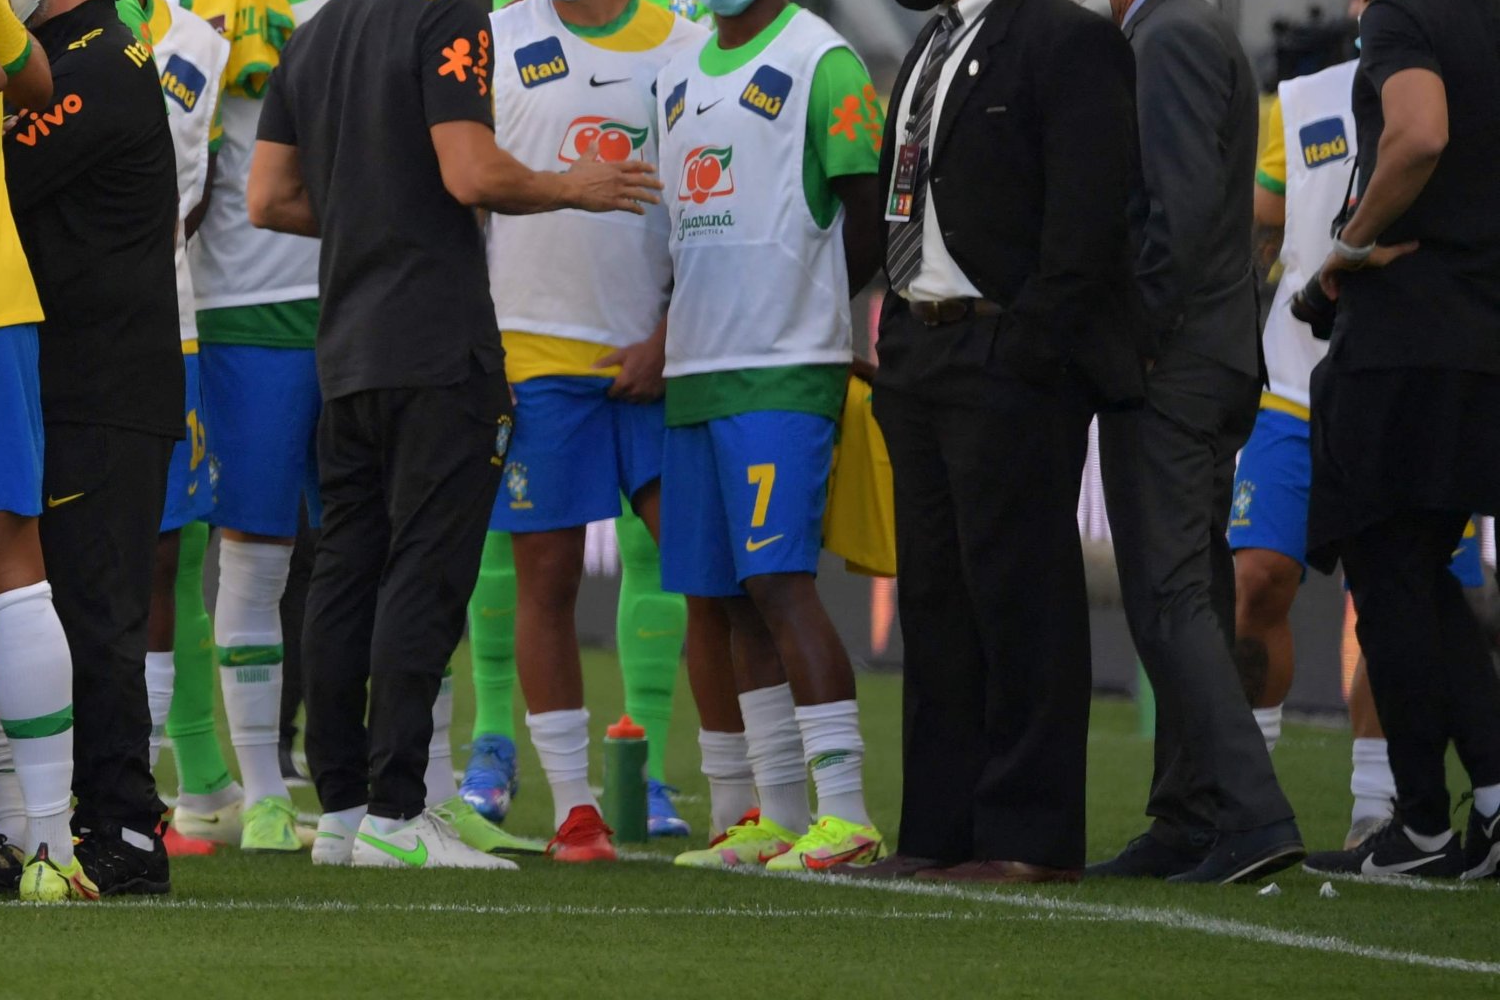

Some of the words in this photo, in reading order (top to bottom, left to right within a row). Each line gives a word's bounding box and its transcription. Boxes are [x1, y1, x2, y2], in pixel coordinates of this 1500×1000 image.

[124, 41, 150, 68] Ita
[521, 56, 566, 84] Itaú
[161, 72, 196, 109] Itaú
[742, 83, 782, 116] Itaú
[16, 93, 82, 147] vivo
[1305, 135, 1346, 165] Itaú
[677, 208, 735, 241] Guaraná
[747, 463, 775, 528] 7
